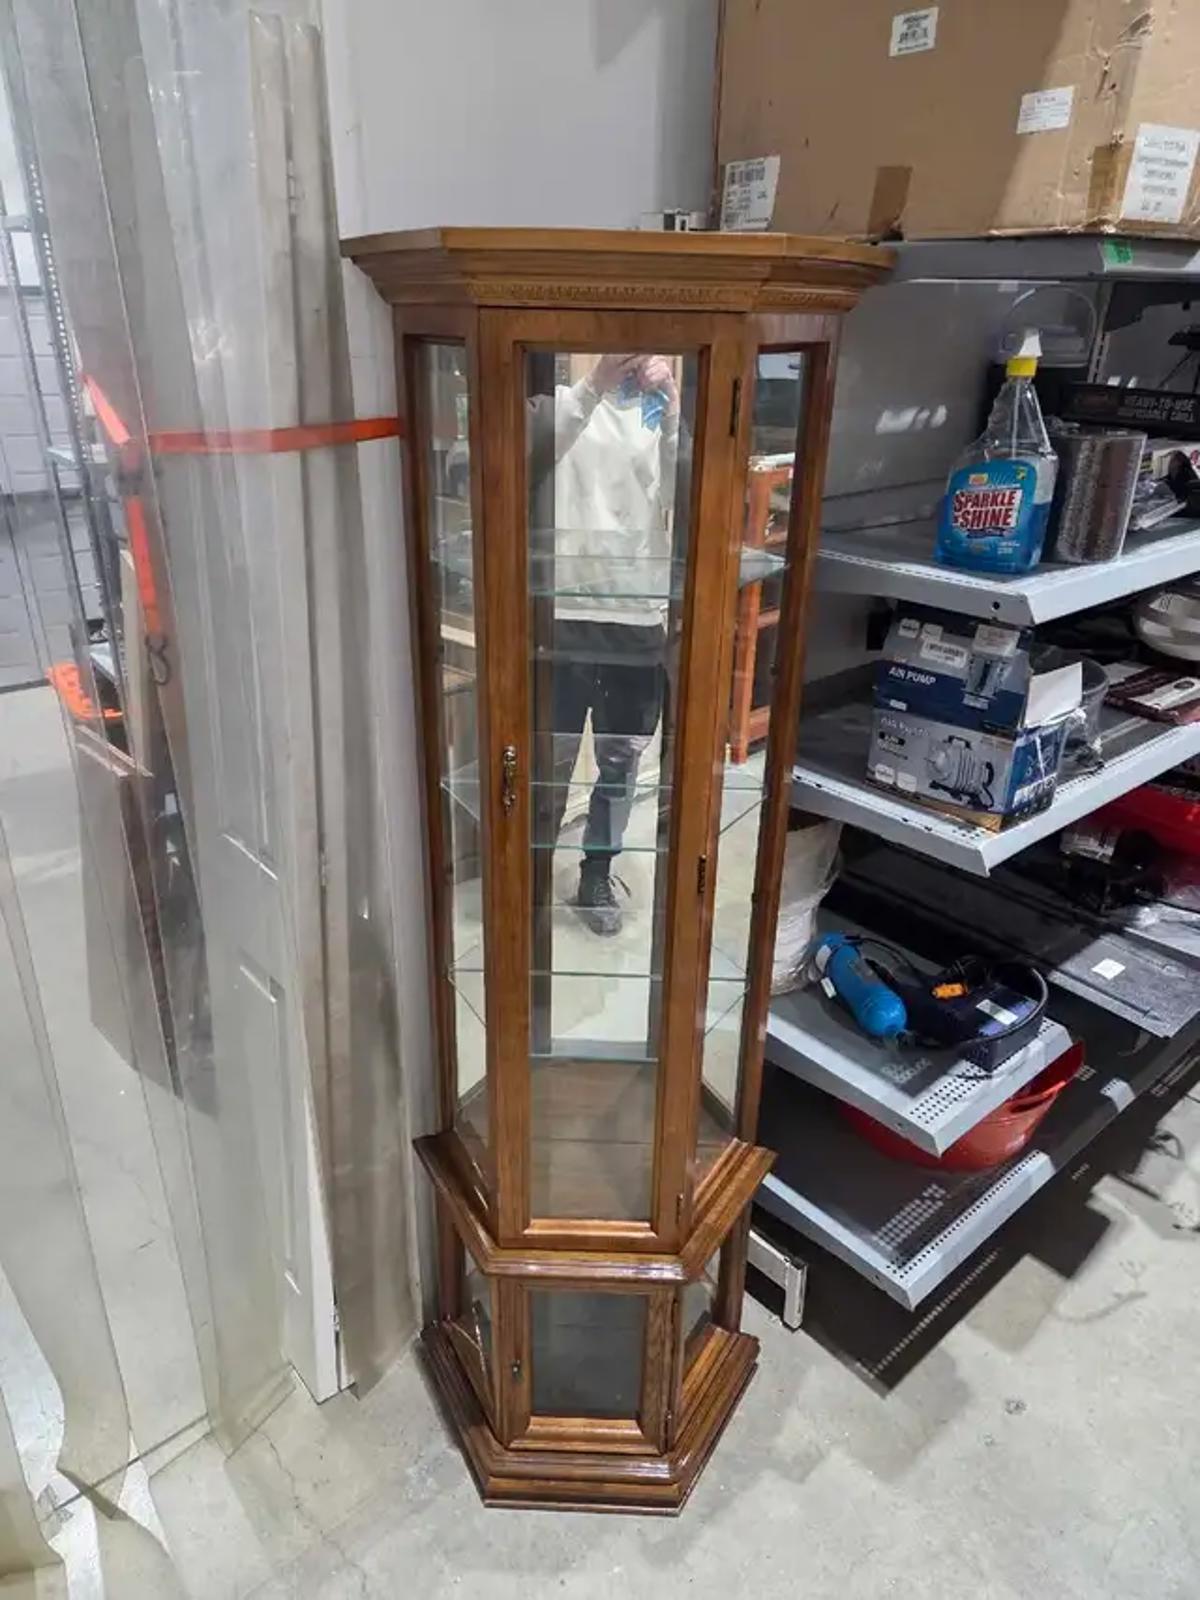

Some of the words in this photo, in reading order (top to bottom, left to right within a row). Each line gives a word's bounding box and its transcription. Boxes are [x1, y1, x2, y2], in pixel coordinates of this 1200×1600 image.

[954, 491, 1016, 512] SPARKLE
[961, 508, 1012, 528] SHINE
[889, 667, 905, 680] AIR
[906, 671, 936, 685] PUMP
